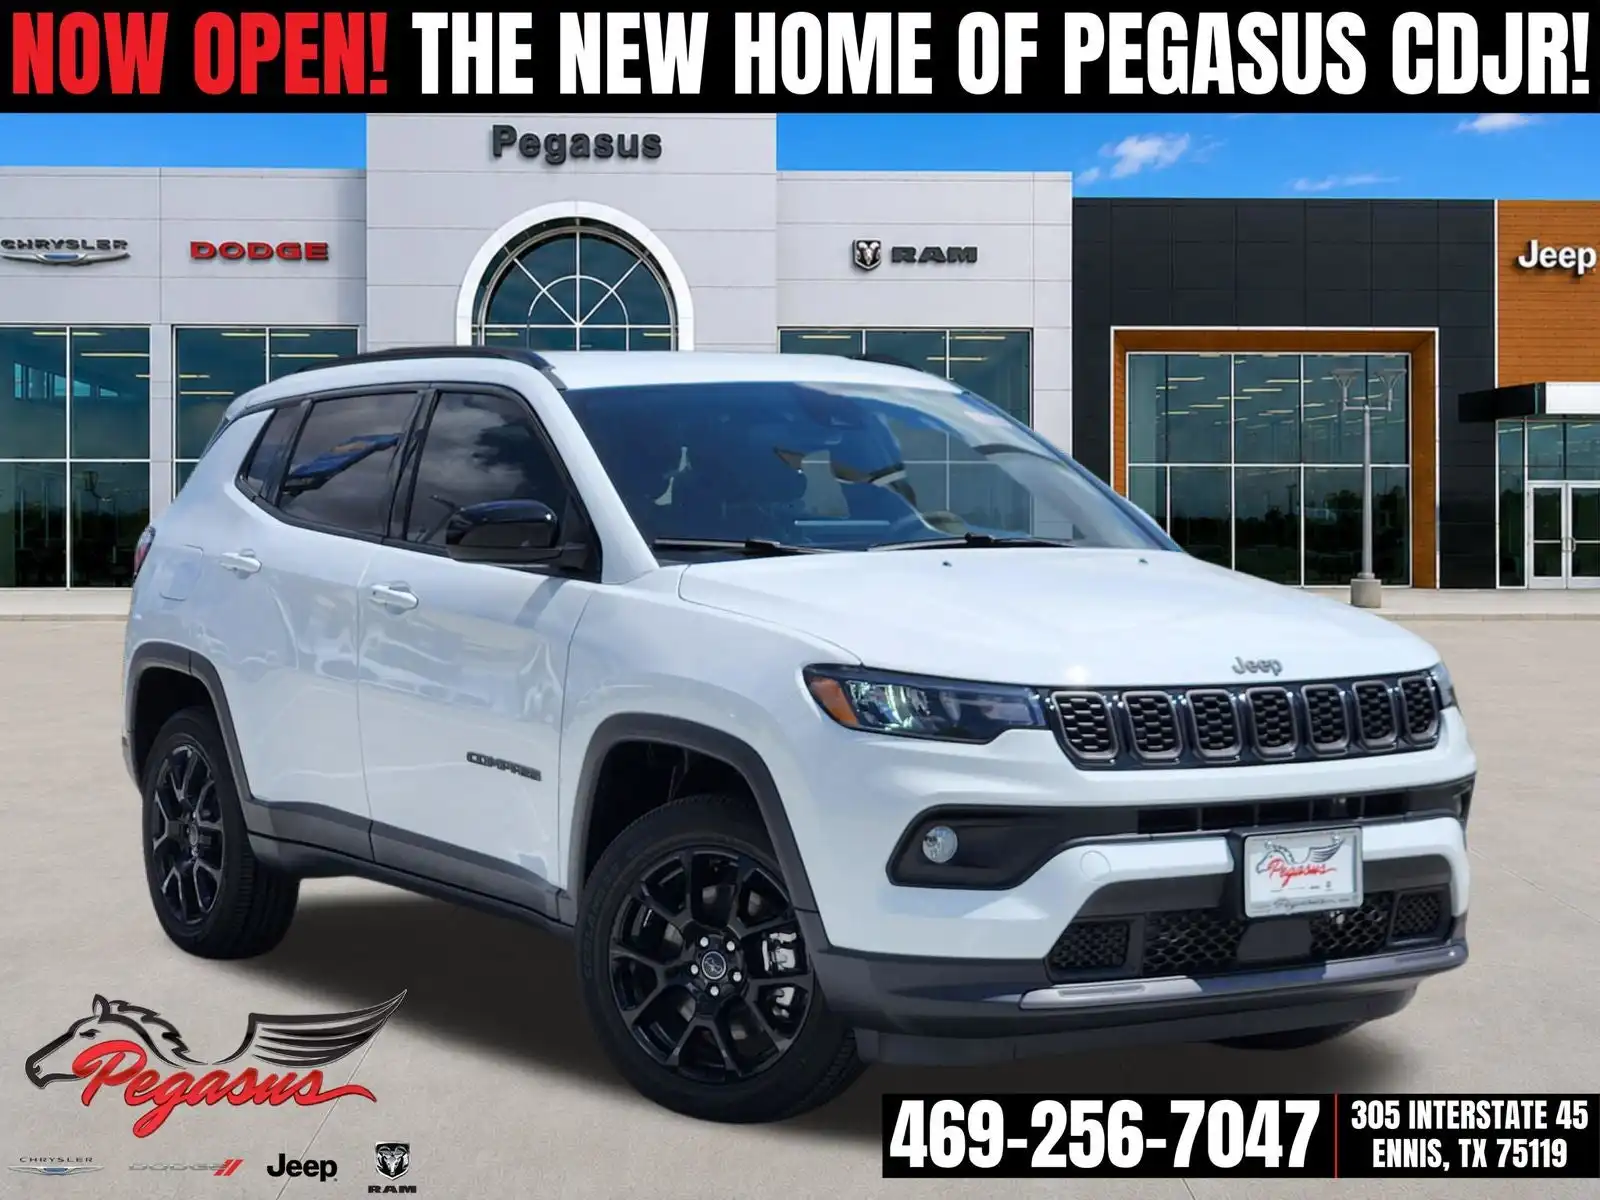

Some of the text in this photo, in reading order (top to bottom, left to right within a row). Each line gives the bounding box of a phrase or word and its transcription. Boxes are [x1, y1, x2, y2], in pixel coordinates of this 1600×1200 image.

[492, 124, 662, 165] Pegasus
[0, 239, 128, 250] CHRYSLER
[190, 241, 329, 261] DODGE
[891, 246, 978, 263] RAM
[1518, 239, 1597, 275] Jeep
[1231, 656, 1282, 677] Jeep
